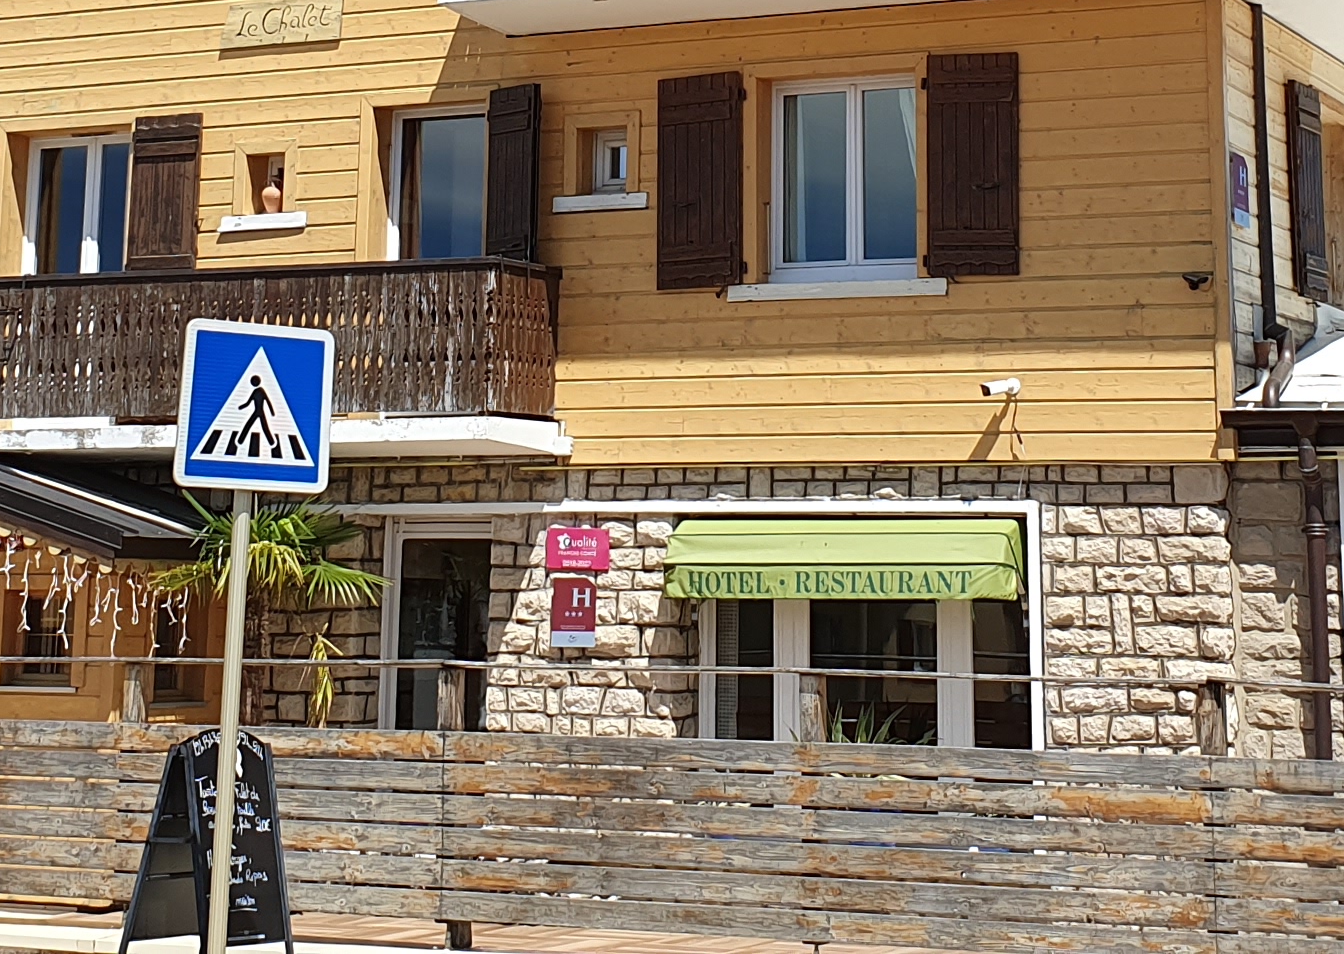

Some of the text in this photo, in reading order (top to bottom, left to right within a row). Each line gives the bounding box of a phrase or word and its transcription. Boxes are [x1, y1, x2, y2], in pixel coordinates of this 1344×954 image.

[235, 3, 333, 38] Le Chalet
[1239, 165, 1247, 187] H
[562, 534, 598, 548] Qualité
[687, 569, 973, 595] HOTEL RESTAURANT
[571, 587, 592, 608] H
